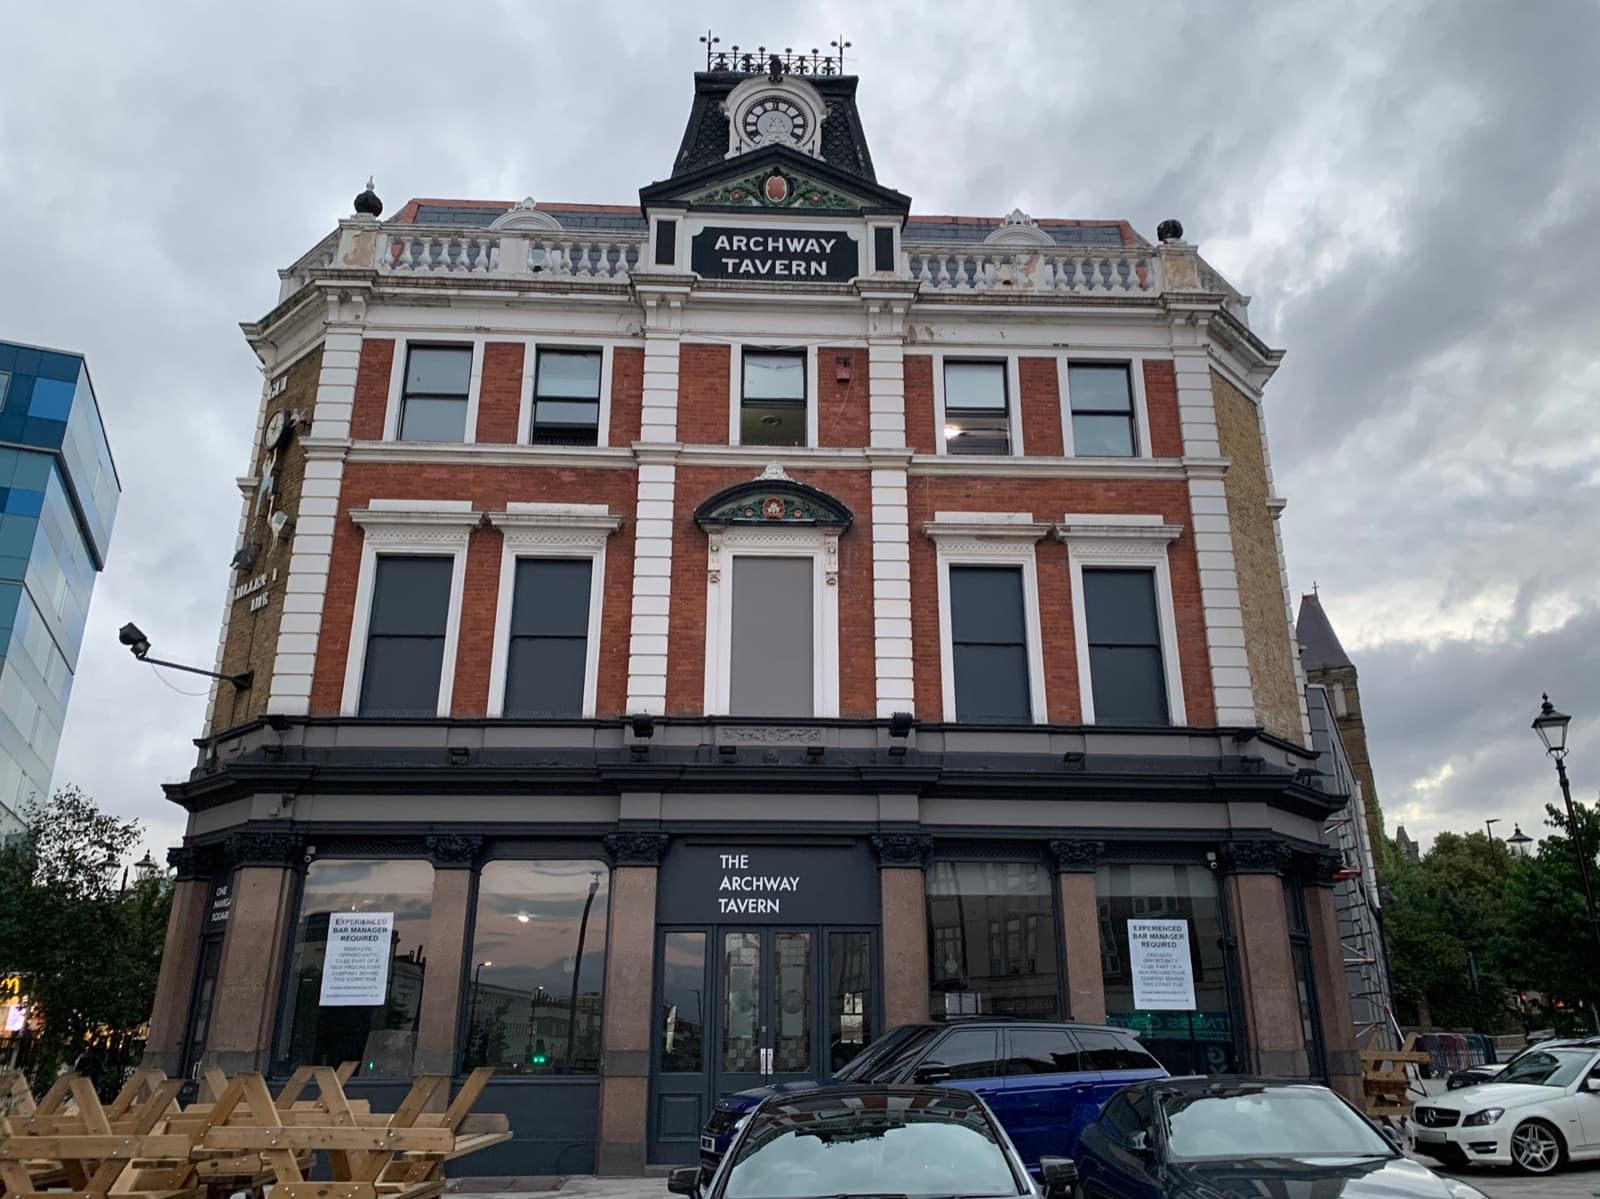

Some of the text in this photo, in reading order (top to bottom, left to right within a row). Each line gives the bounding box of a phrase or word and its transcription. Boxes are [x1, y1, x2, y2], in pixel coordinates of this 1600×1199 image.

[714, 235, 837, 254] ARCHWAY
[721, 258, 828, 276] TAVERN
[719, 854, 749, 869] THE
[719, 875, 800, 891] ARCHWAY
[718, 898, 780, 914] TAVERN
[336, 918, 388, 926] EXPERIENCED
